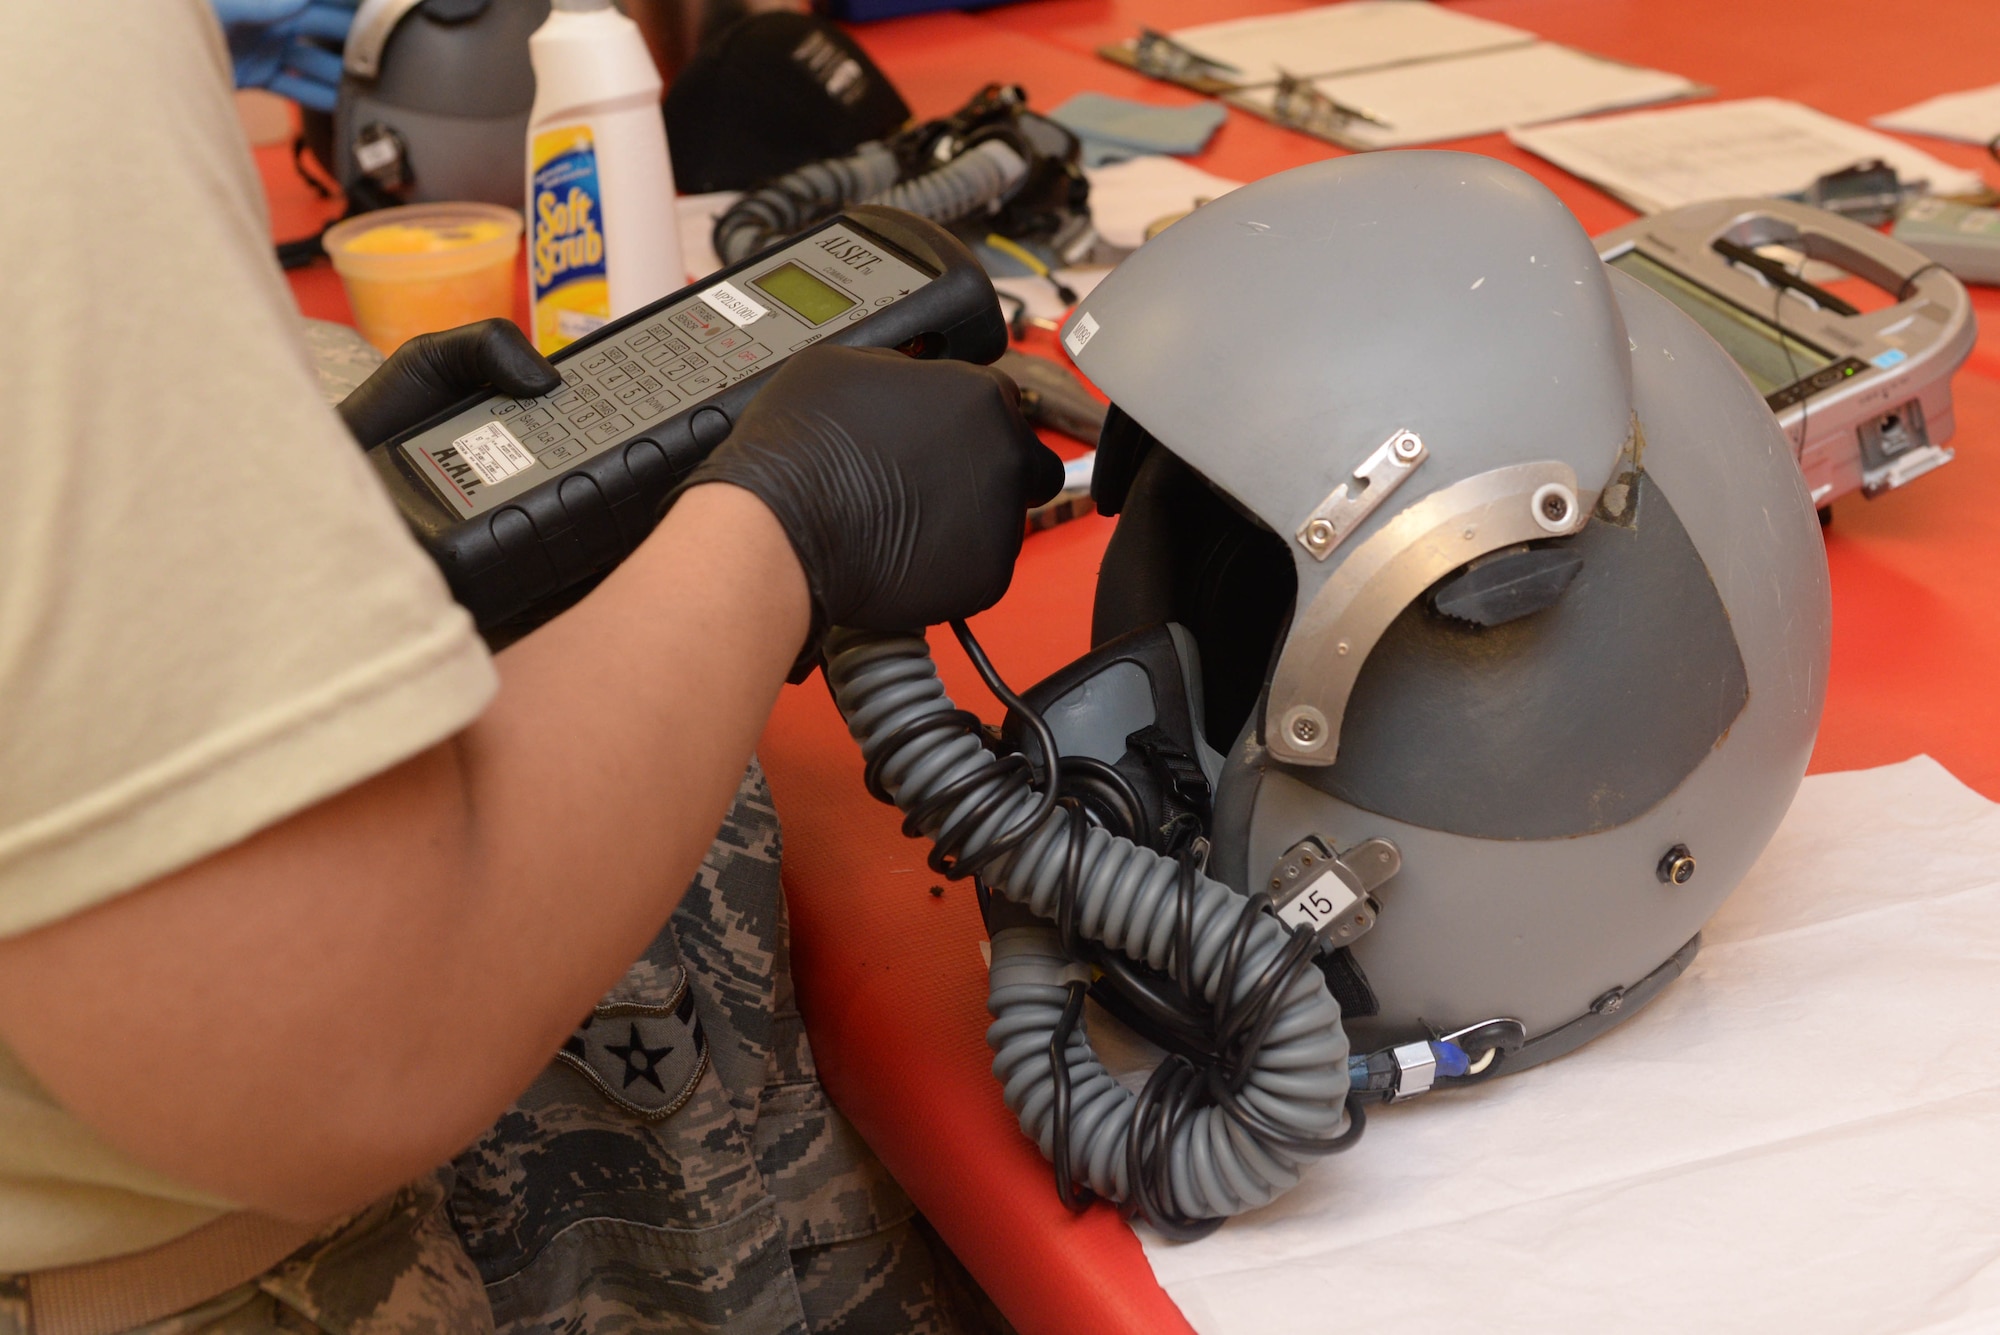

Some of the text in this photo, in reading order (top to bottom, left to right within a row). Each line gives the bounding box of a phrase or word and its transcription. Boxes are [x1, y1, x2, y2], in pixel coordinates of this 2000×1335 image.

[537, 186, 594, 238] Soft
[536, 218, 603, 287] Scrub
[815, 236, 883, 271] ALSET
[822, 266, 853, 285] COMMAND
[711, 289, 759, 321] MP2LS100H
[691, 305, 716, 322] STROBE
[675, 313, 699, 331] SENSOR
[650, 325, 669, 338] BATT
[633, 335, 651, 346] 0
[668, 339, 687, 353] CUST
[720, 337, 735, 349] ON
[608, 349, 623, 360] NEW
[652, 351, 670, 361] 1
[686, 353, 705, 367] VOLT
[738, 350, 758, 362] OFF
[588, 358, 607, 369] 3
[623, 364, 641, 376] EDIT
[667, 364, 686, 376] 2
[608, 374, 624, 385] 4
[694, 374, 710, 385] UP
[622, 387, 642, 399] 5
[559, 396, 579, 407] 7
[594, 401, 614, 415] OHMS
[645, 396, 666, 413] DOWN
[498, 404, 517, 415] 9
[519, 414, 541, 431] SAVE
[576, 411, 595, 423] 8
[599, 421, 620, 436] EXIT
[536, 431, 554, 445] CLR
[552, 446, 572, 460] ENT
[431, 446, 483, 496] A.A.I.
[1299, 890, 1332, 921] 15
